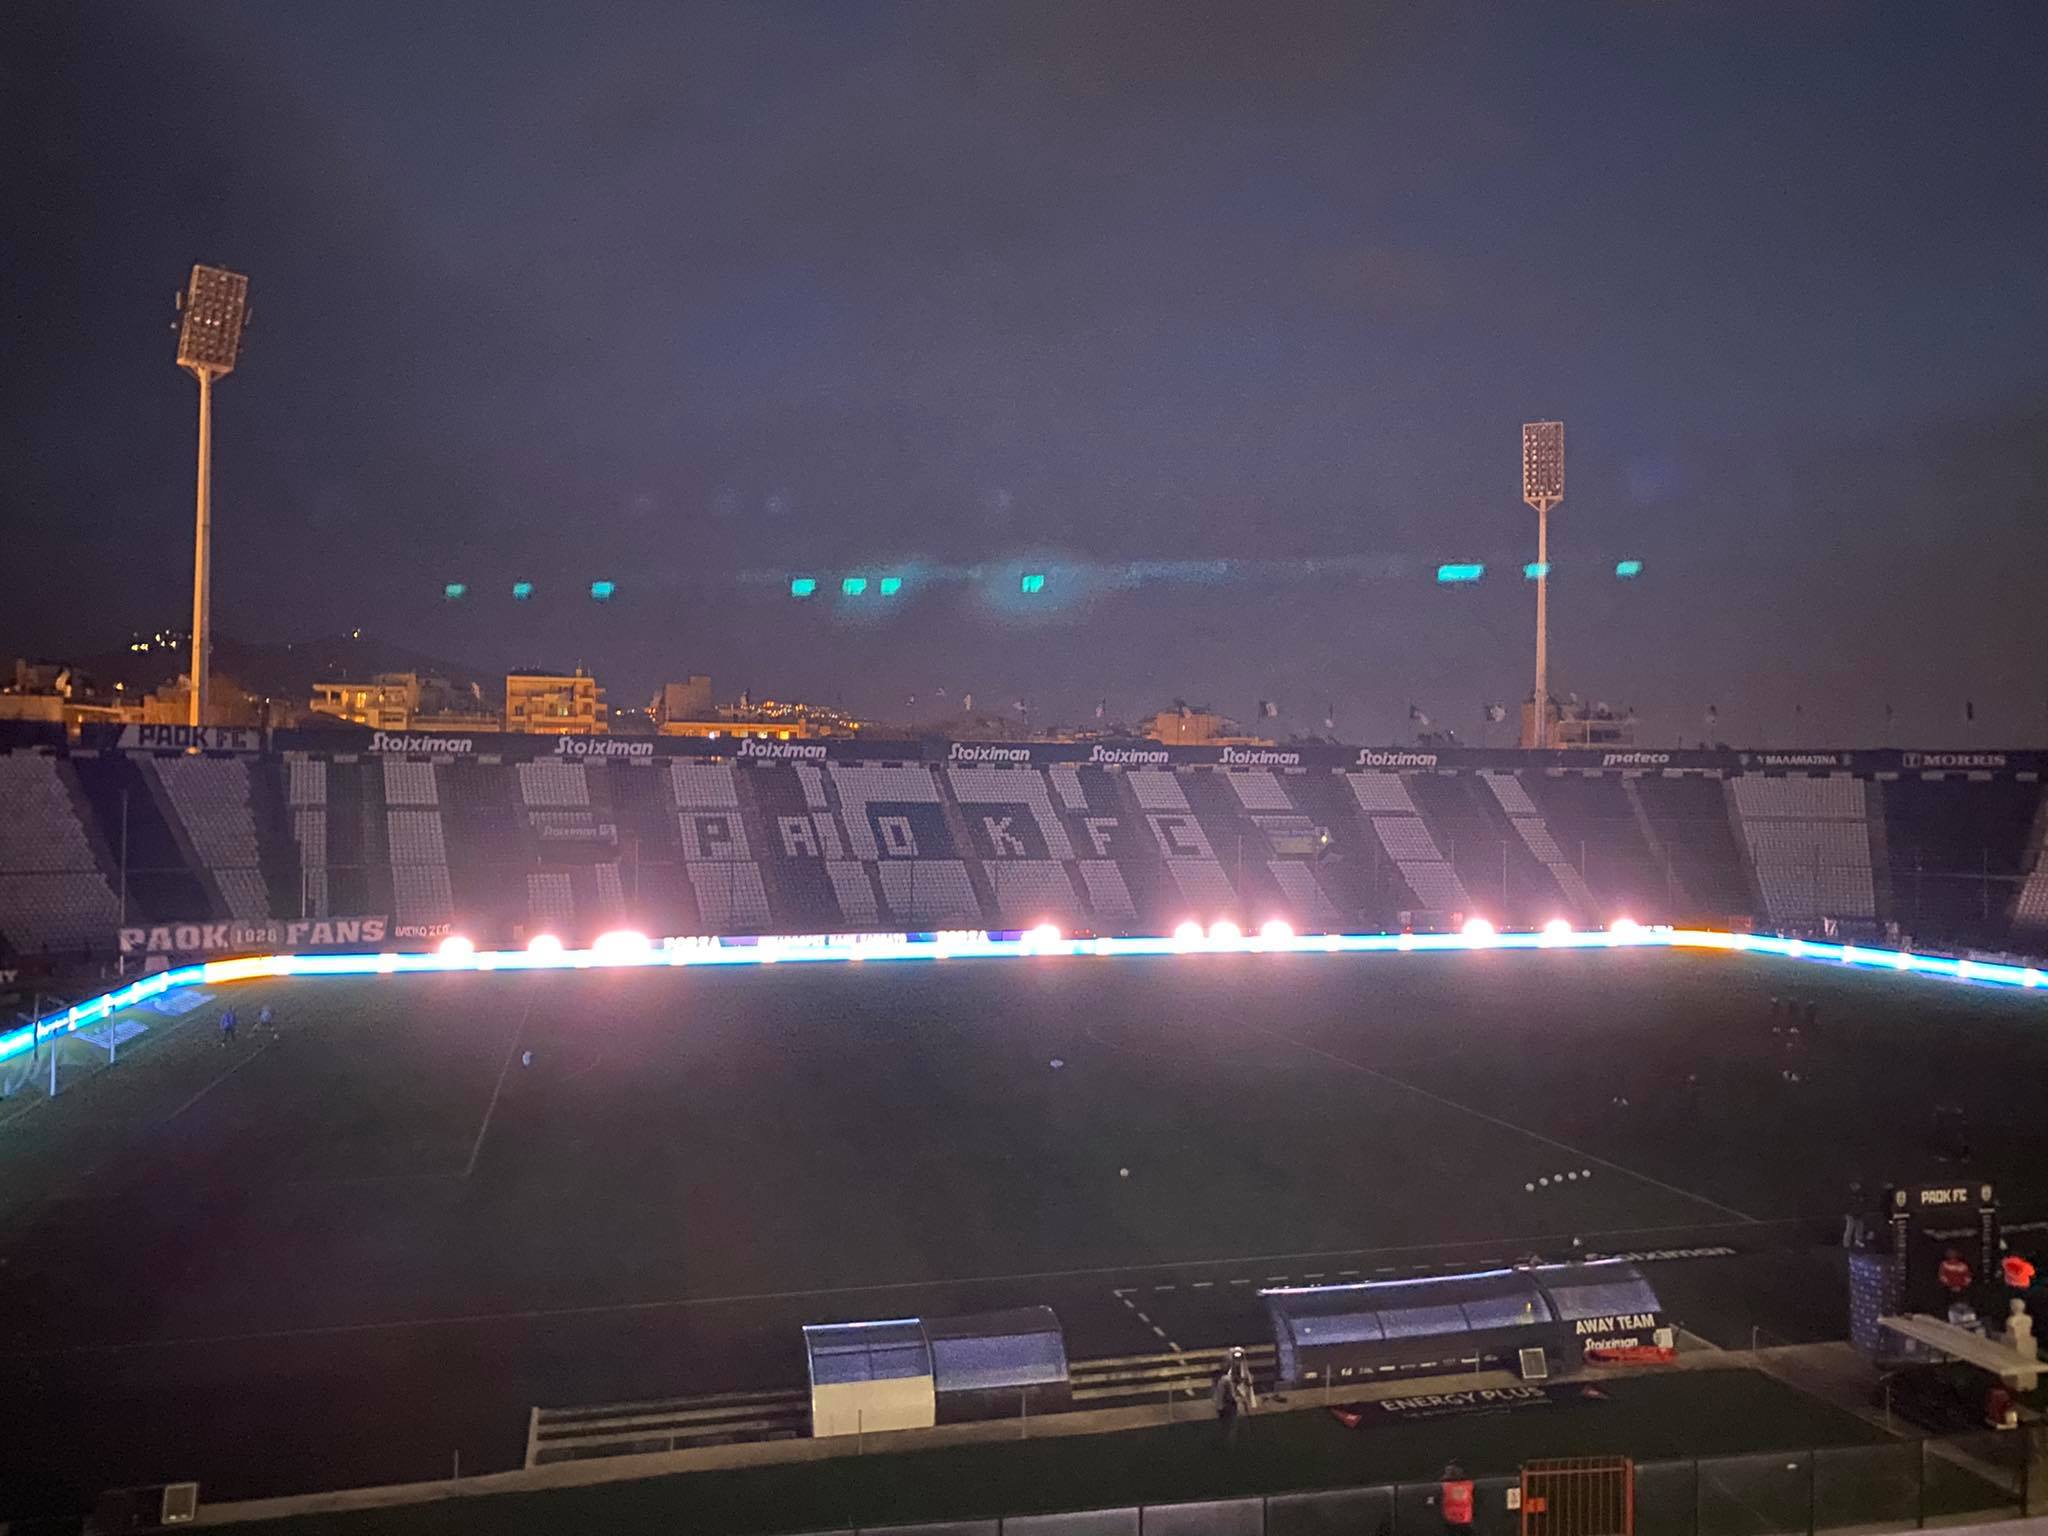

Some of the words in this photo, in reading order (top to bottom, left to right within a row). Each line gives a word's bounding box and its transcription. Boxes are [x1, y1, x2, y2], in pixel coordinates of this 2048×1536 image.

[139, 725, 208, 747] PAOK
[216, 727, 247, 748] FC
[368, 731, 473, 752] Stoiximan
[555, 734, 655, 757] Stoiximan
[737, 738, 827, 760] Stoiximan
[948, 742, 1030, 763] Stoiximan
[1089, 745, 1169, 765] Stoiximan
[1219, 747, 1299, 767] Stoiximan
[1356, 749, 1437, 768] Stoiximan
[1602, 751, 1671, 767] mateco
[1923, 754, 2006, 767] MORRIS
[119, 925, 229, 951] PAOK
[287, 920, 385, 945] FANS
[1921, 1189, 1951, 1205] PAOK
[1953, 1188, 1968, 1201] FC
[1576, 1316, 1615, 1335] AWAY
[1617, 1314, 1656, 1330] TEAM
[1584, 1337, 1639, 1351] Stoiximan
[1380, 1391, 1476, 1413] ENERGY
[1481, 1386, 1547, 1402] PLUS
